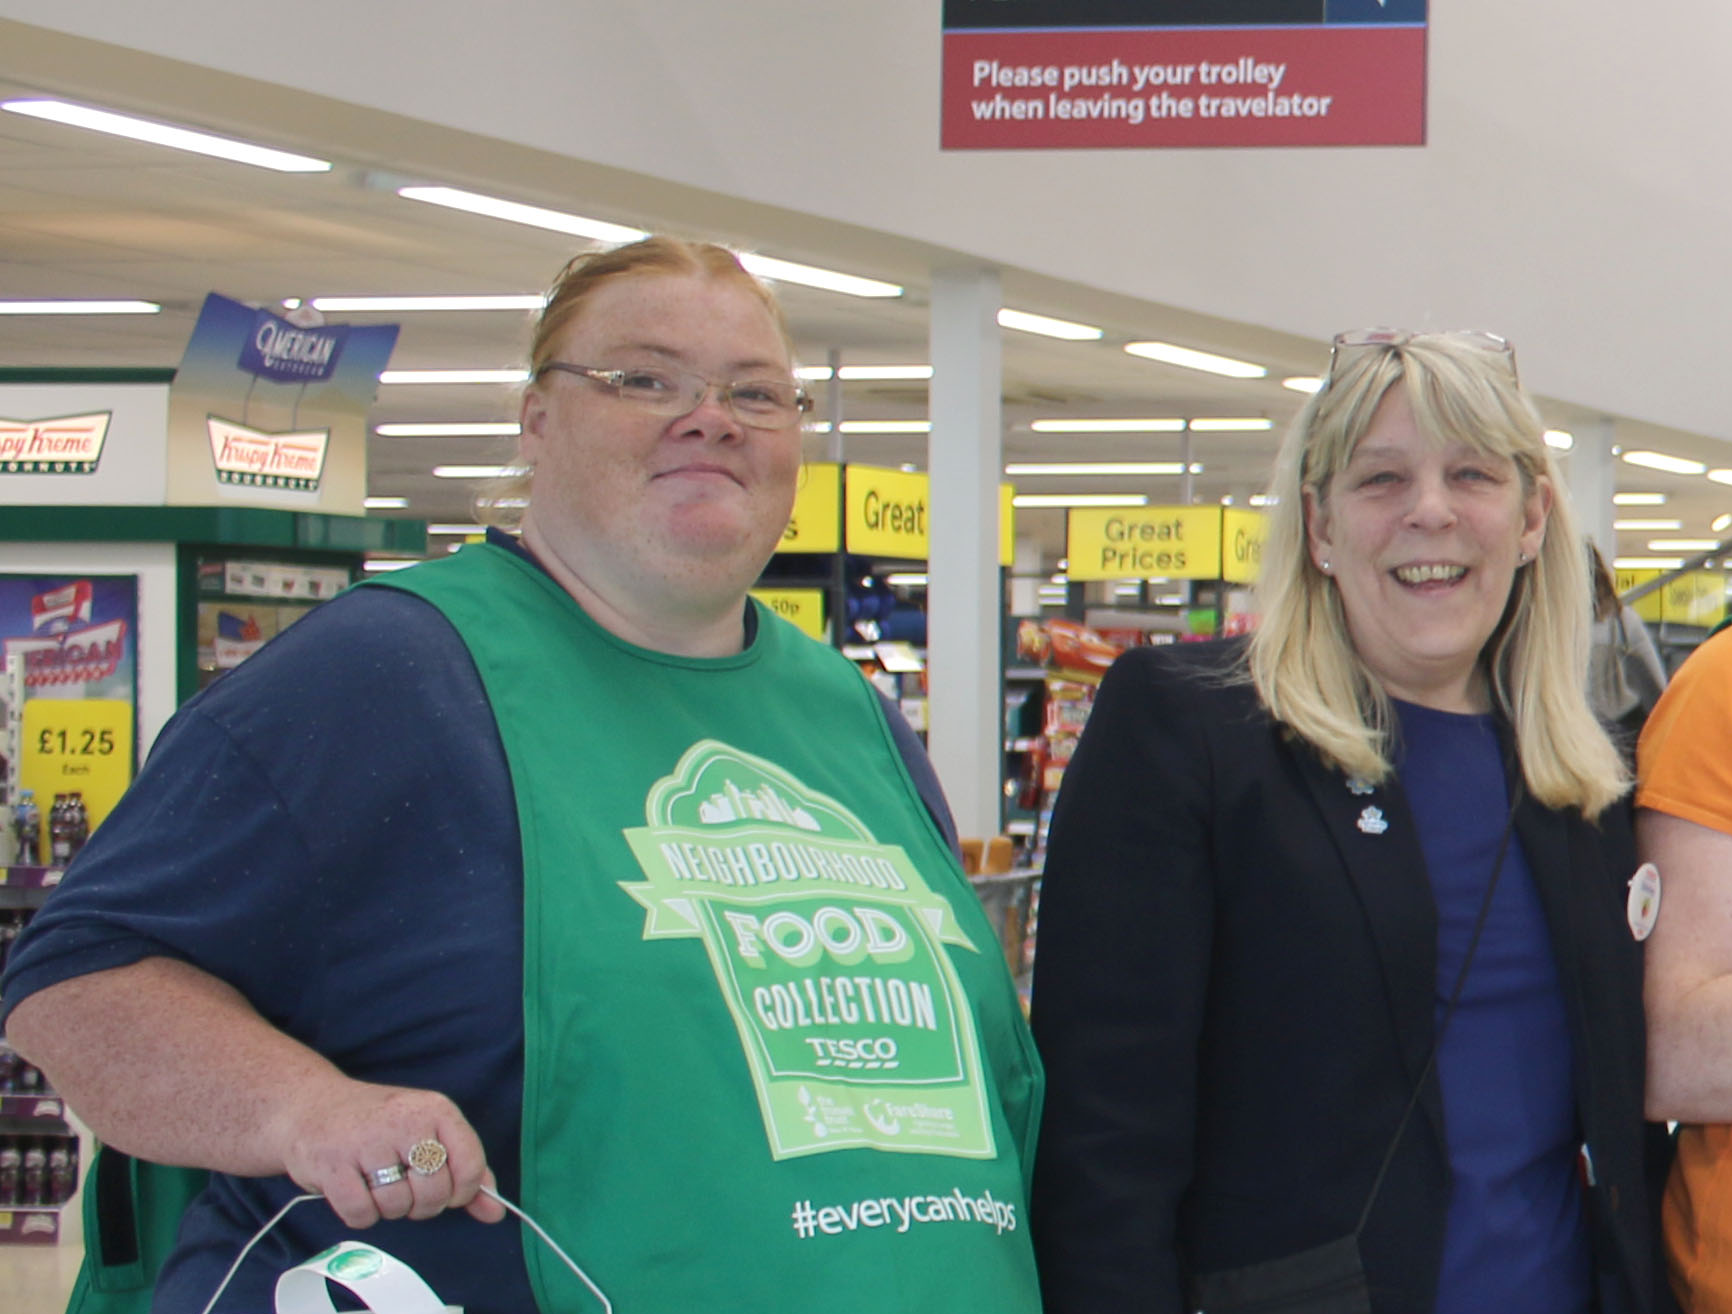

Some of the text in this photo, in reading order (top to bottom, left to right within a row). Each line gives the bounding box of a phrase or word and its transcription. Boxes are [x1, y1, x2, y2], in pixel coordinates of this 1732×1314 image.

[972, 57, 1286, 91] Please push your trolley
[972, 92, 1332, 124] when leaving the travelator
[28, 427, 93, 454] Kreme
[219, 436, 318, 472] Krispy Kreme
[864, 490, 926, 537] Great
[1105, 517, 1184, 543] Great
[1101, 548, 1187, 571] Prices
[38, 728, 115, 756] £1.25
[62, 764, 90, 776] Each
[660, 842, 908, 892] NEIGHBOURHOOD
[723, 905, 908, 961] FOOD
[753, 976, 938, 1032] COLLECTION
[805, 1037, 898, 1062] TESCO
[792, 1186, 1017, 1240] #everycanhelps
